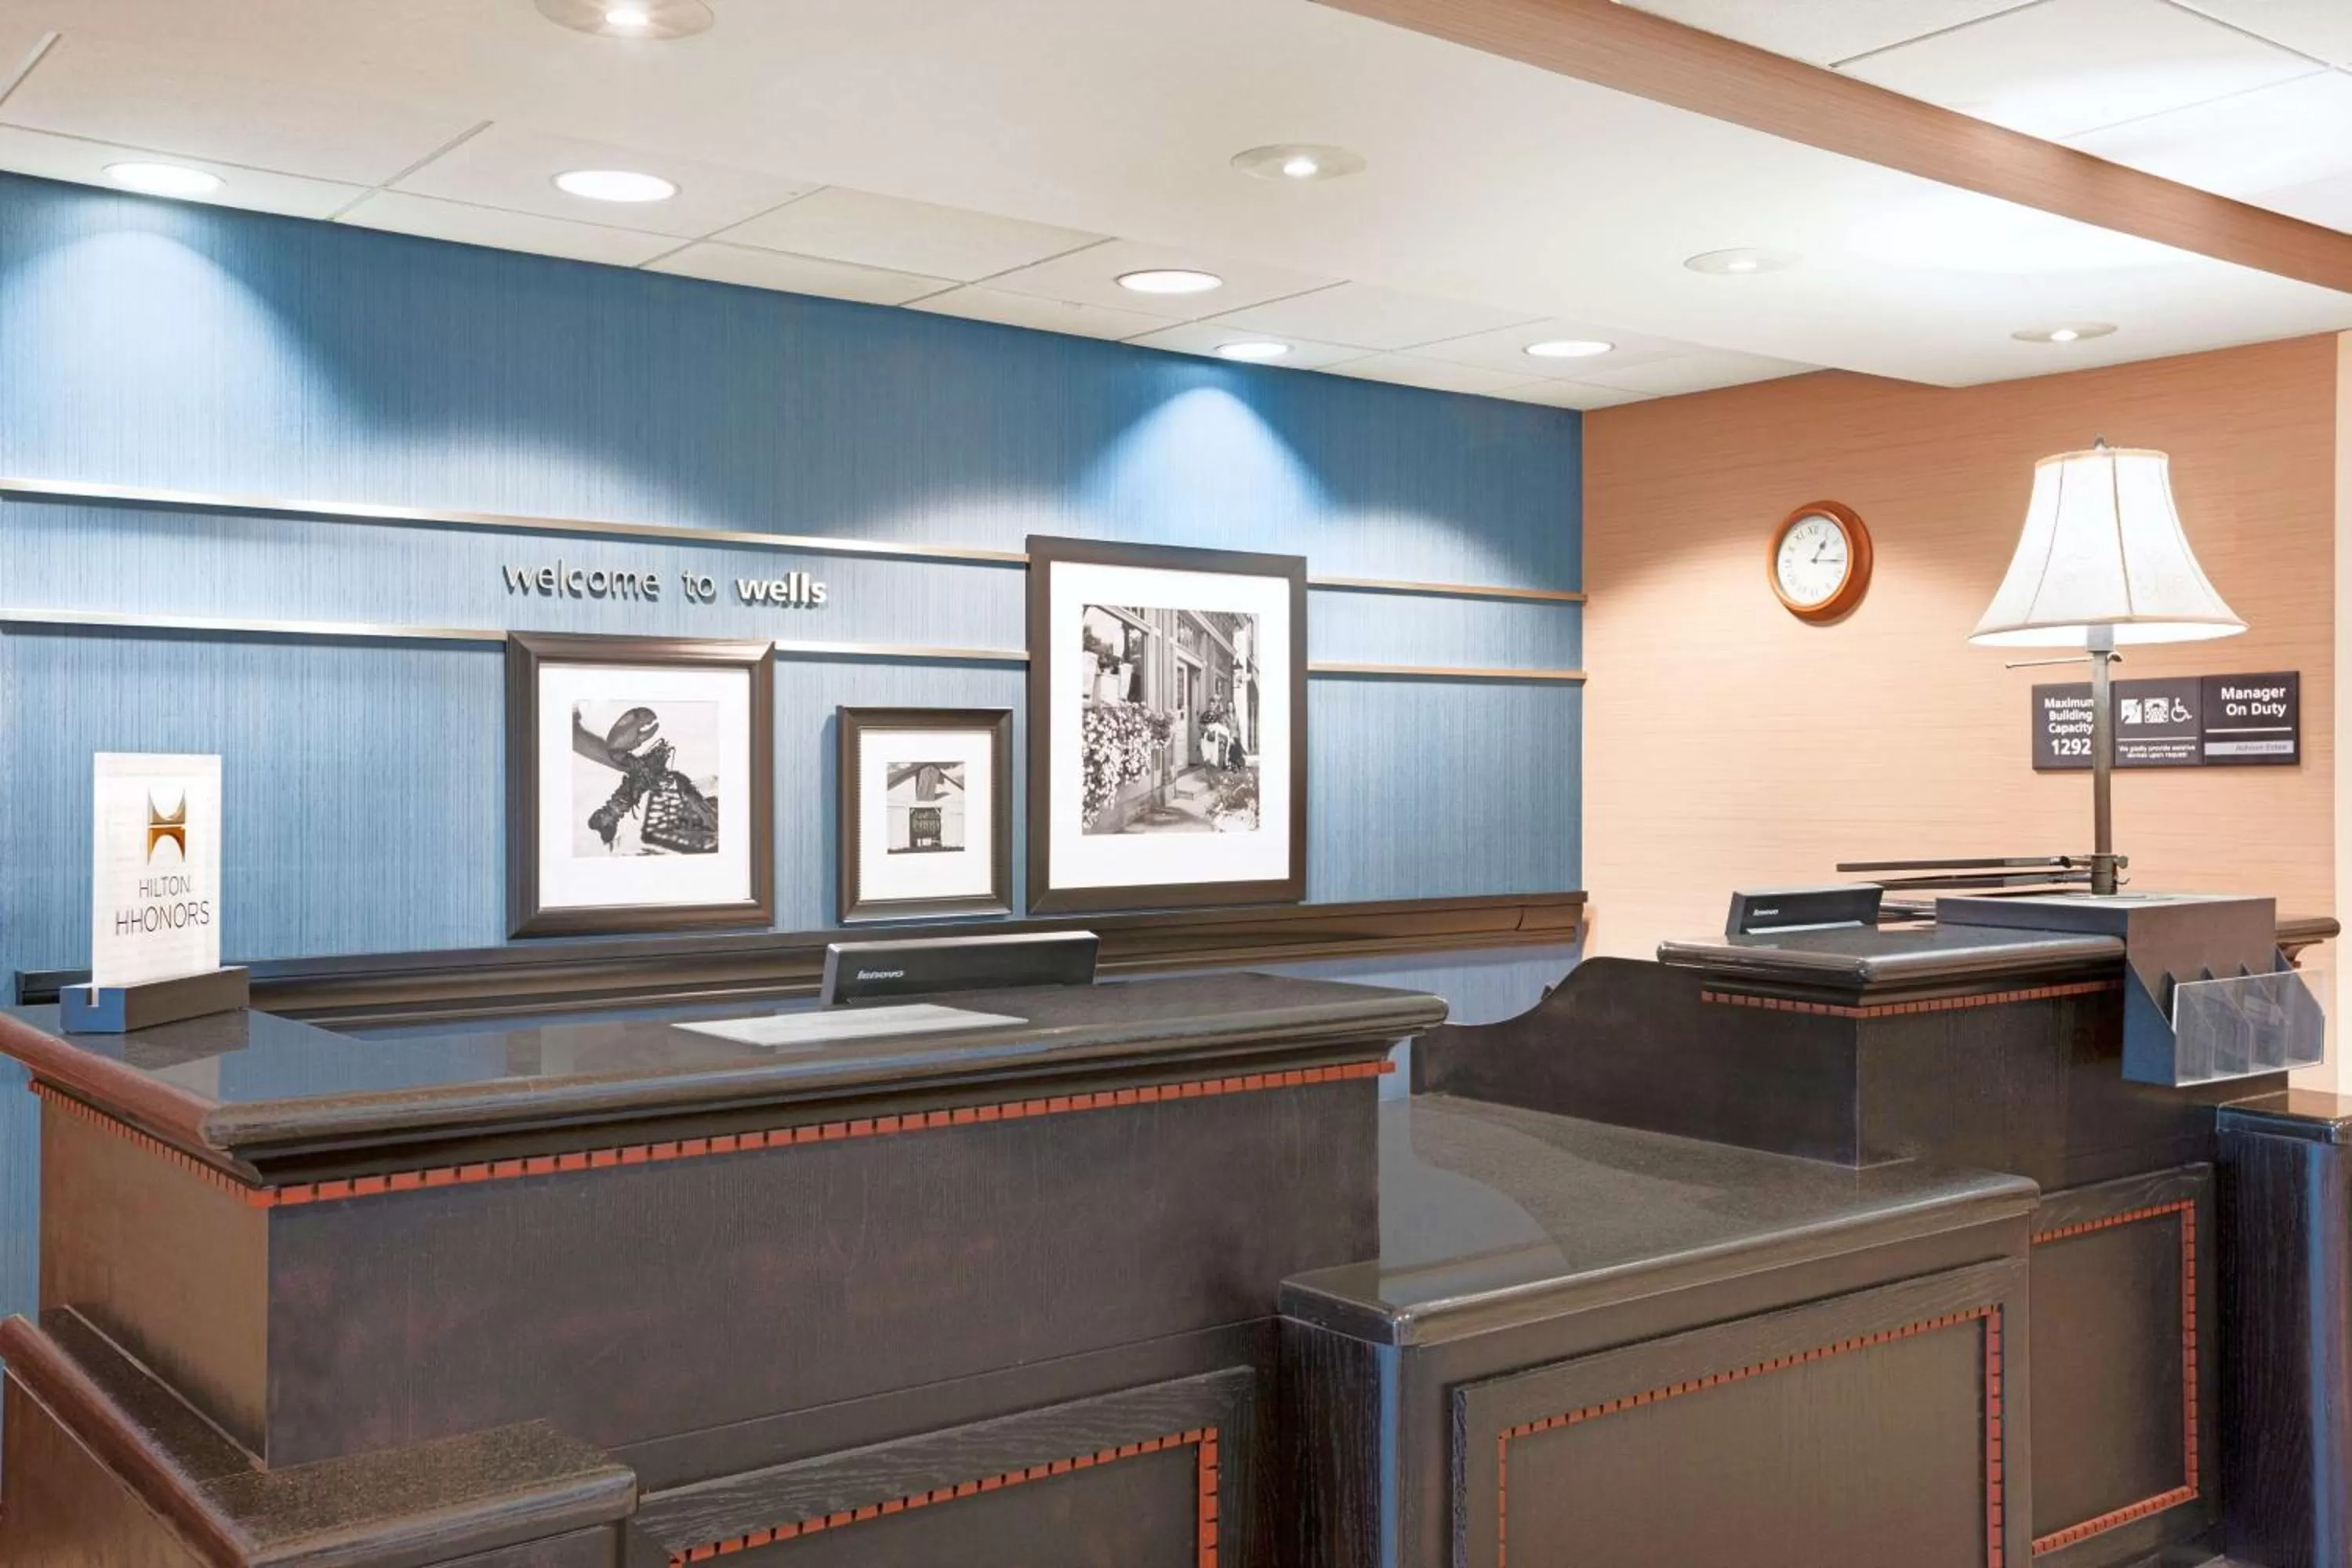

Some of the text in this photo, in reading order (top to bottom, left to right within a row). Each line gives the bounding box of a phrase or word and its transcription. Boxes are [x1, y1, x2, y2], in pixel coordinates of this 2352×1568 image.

[503, 559, 829, 604] welcome to wells
[2221, 687, 2286, 702] Manager
[2049, 709, 2092, 722] Building
[2226, 702, 2287, 717] On Duty
[2049, 722, 2094, 735] Capacity
[2051, 738, 2092, 755] 1292
[138, 875, 191, 898] HILTON
[115, 901, 210, 936] HHONORS
[856, 970, 905, 979] lenovo
